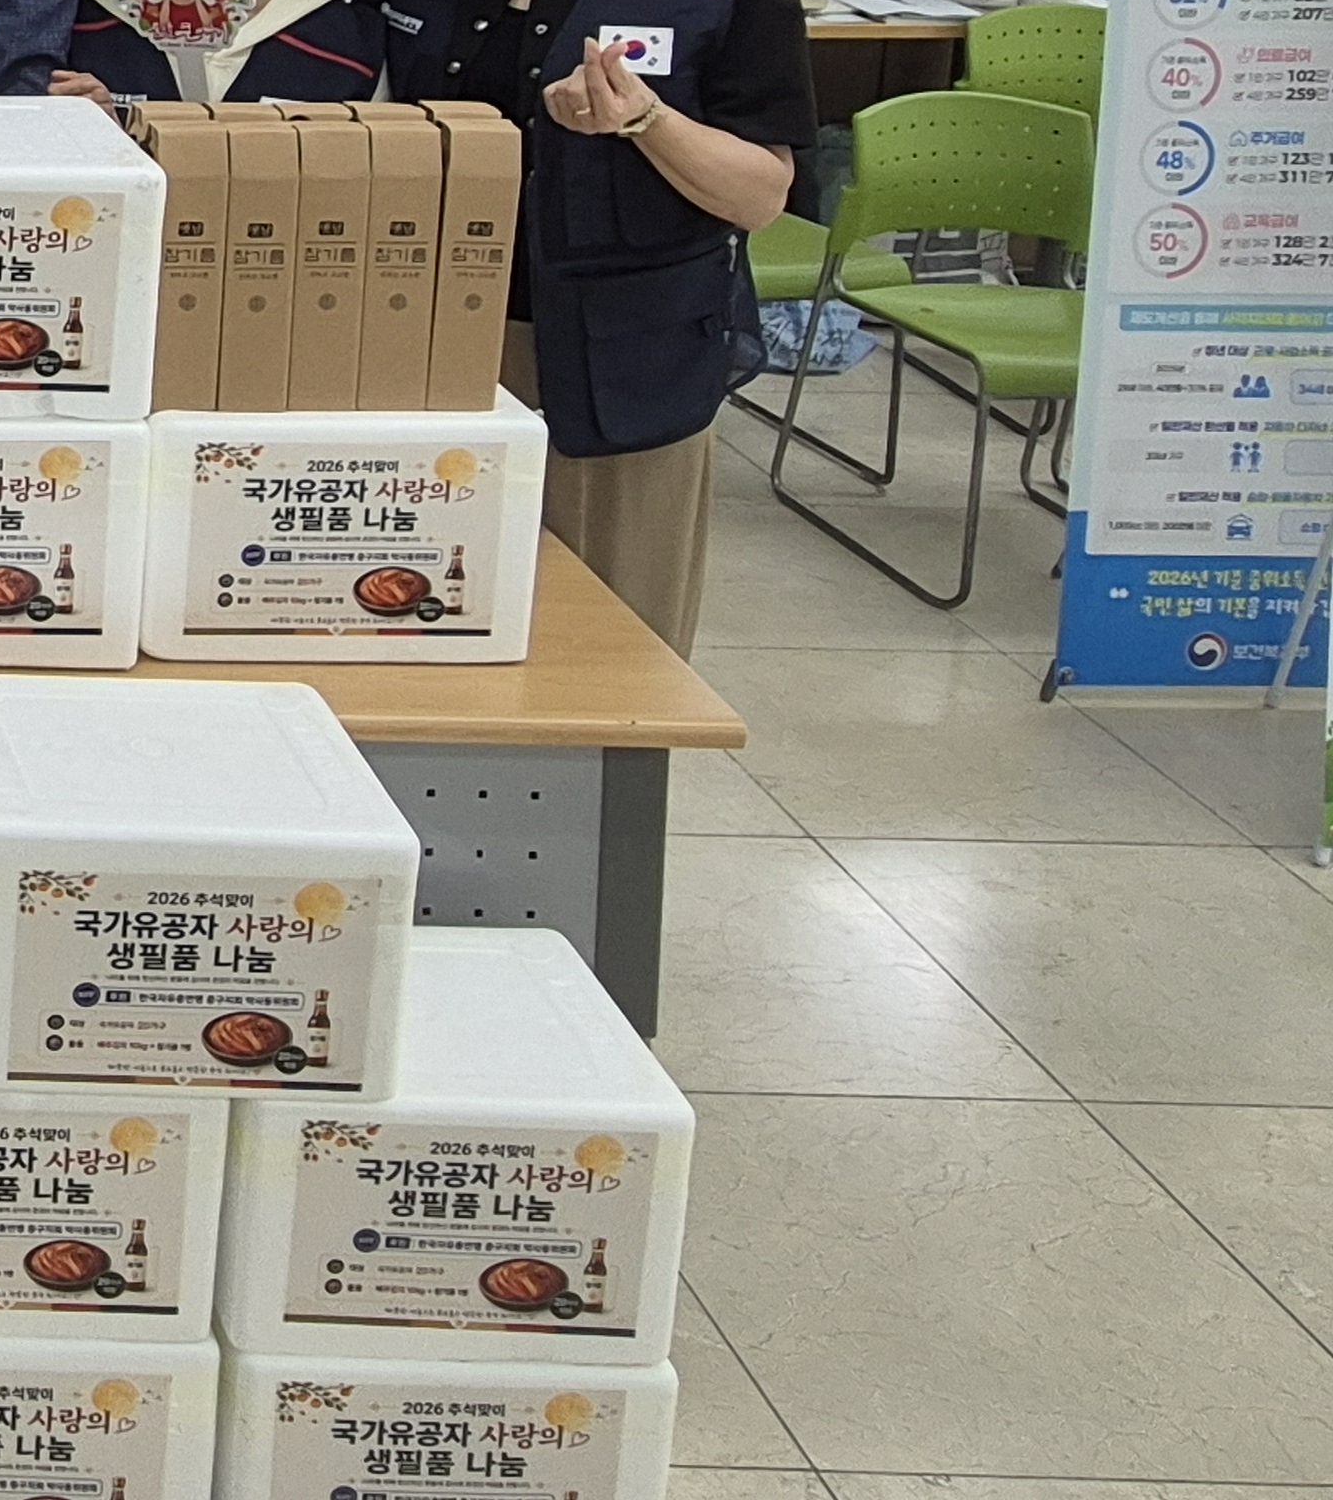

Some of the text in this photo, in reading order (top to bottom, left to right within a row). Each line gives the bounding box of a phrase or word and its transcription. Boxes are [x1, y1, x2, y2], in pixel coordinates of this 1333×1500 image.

[306, 459, 399, 474] 2026 추석맞이
[242, 477, 451, 504] 국가유공자 사랑의
[270, 506, 419, 532] 생필품 나눔
[147, 891, 254, 909] 2026 추석맞이
[73, 910, 315, 944] 국가유공자 사랑의
[106, 942, 277, 974] 생필품 나눔
[13, 1127, 71, 1143] 추석맞이
[44, 1147, 130, 1176] 사랑의
[356, 1158, 594, 1194] 국가유공자 사랑의
[33, 1177, 94, 1205] 나눔
[387, 1190, 556, 1223] 생필품 나눔
[27, 1405, 111, 1435] 사랑의
[331, 1419, 564, 1450] 국가유공자 사랑의
[16, 1434, 76, 1462] 나눔
[363, 1449, 528, 1478] 생필품 나눔
